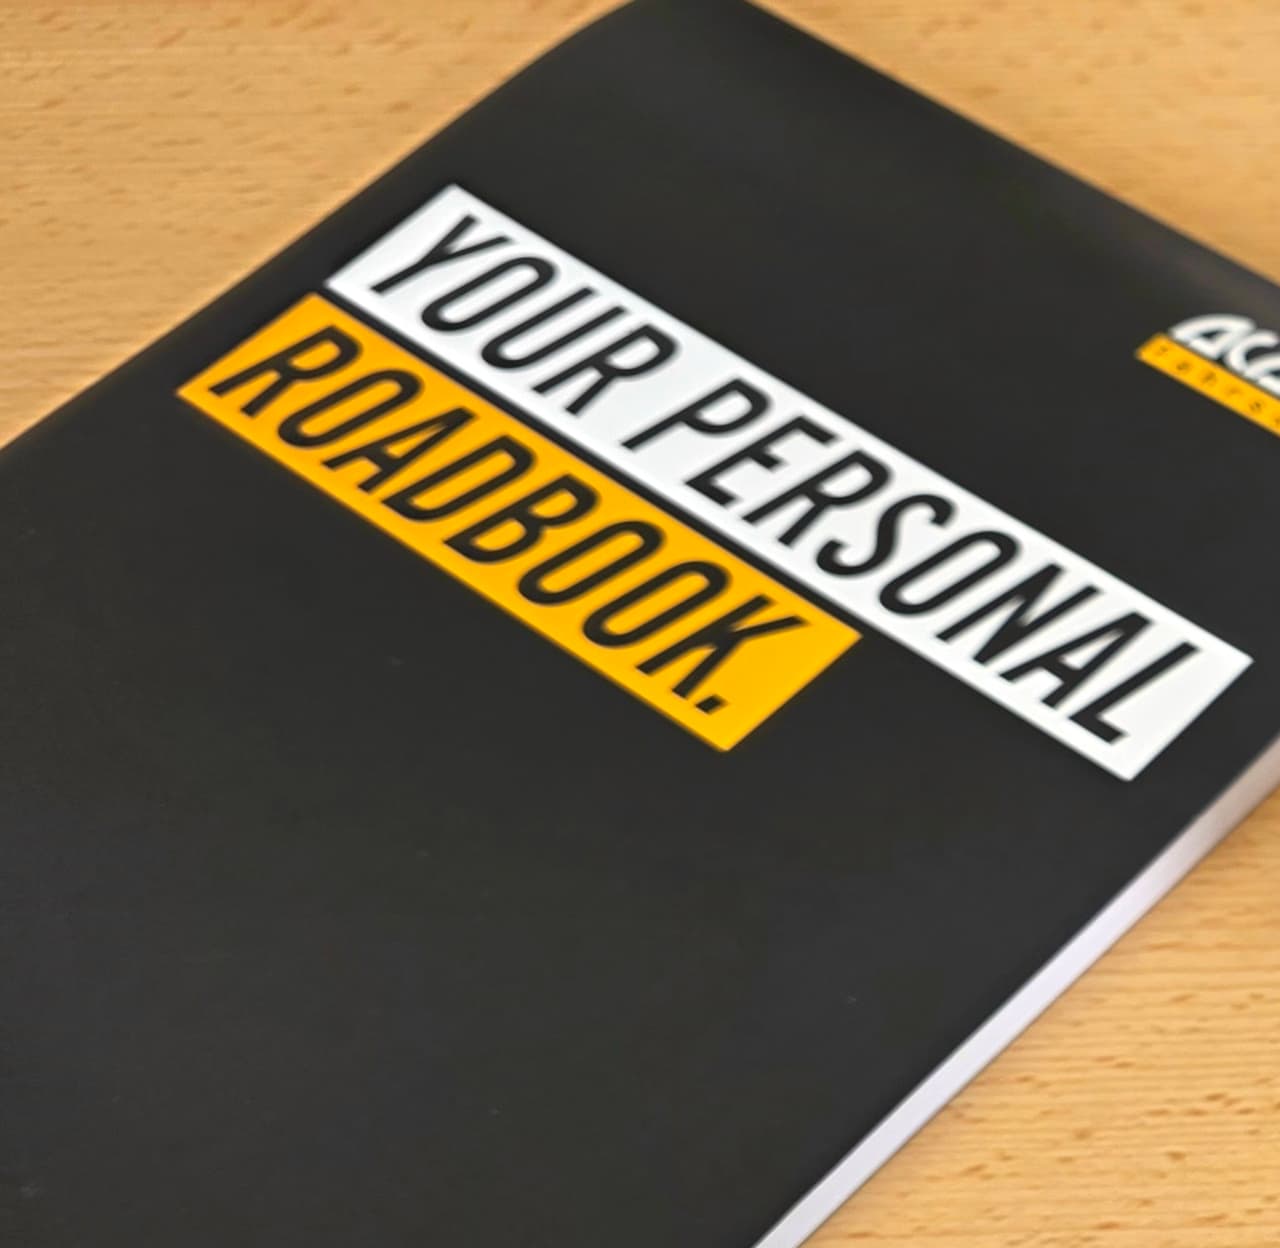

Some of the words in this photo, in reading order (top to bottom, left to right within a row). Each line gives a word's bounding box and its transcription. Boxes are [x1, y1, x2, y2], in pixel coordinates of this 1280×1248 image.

[208, 325, 809, 714] ROADBOOK.
[371, 214, 679, 416] YOUR
[621, 377, 1203, 745] PERSONAL
